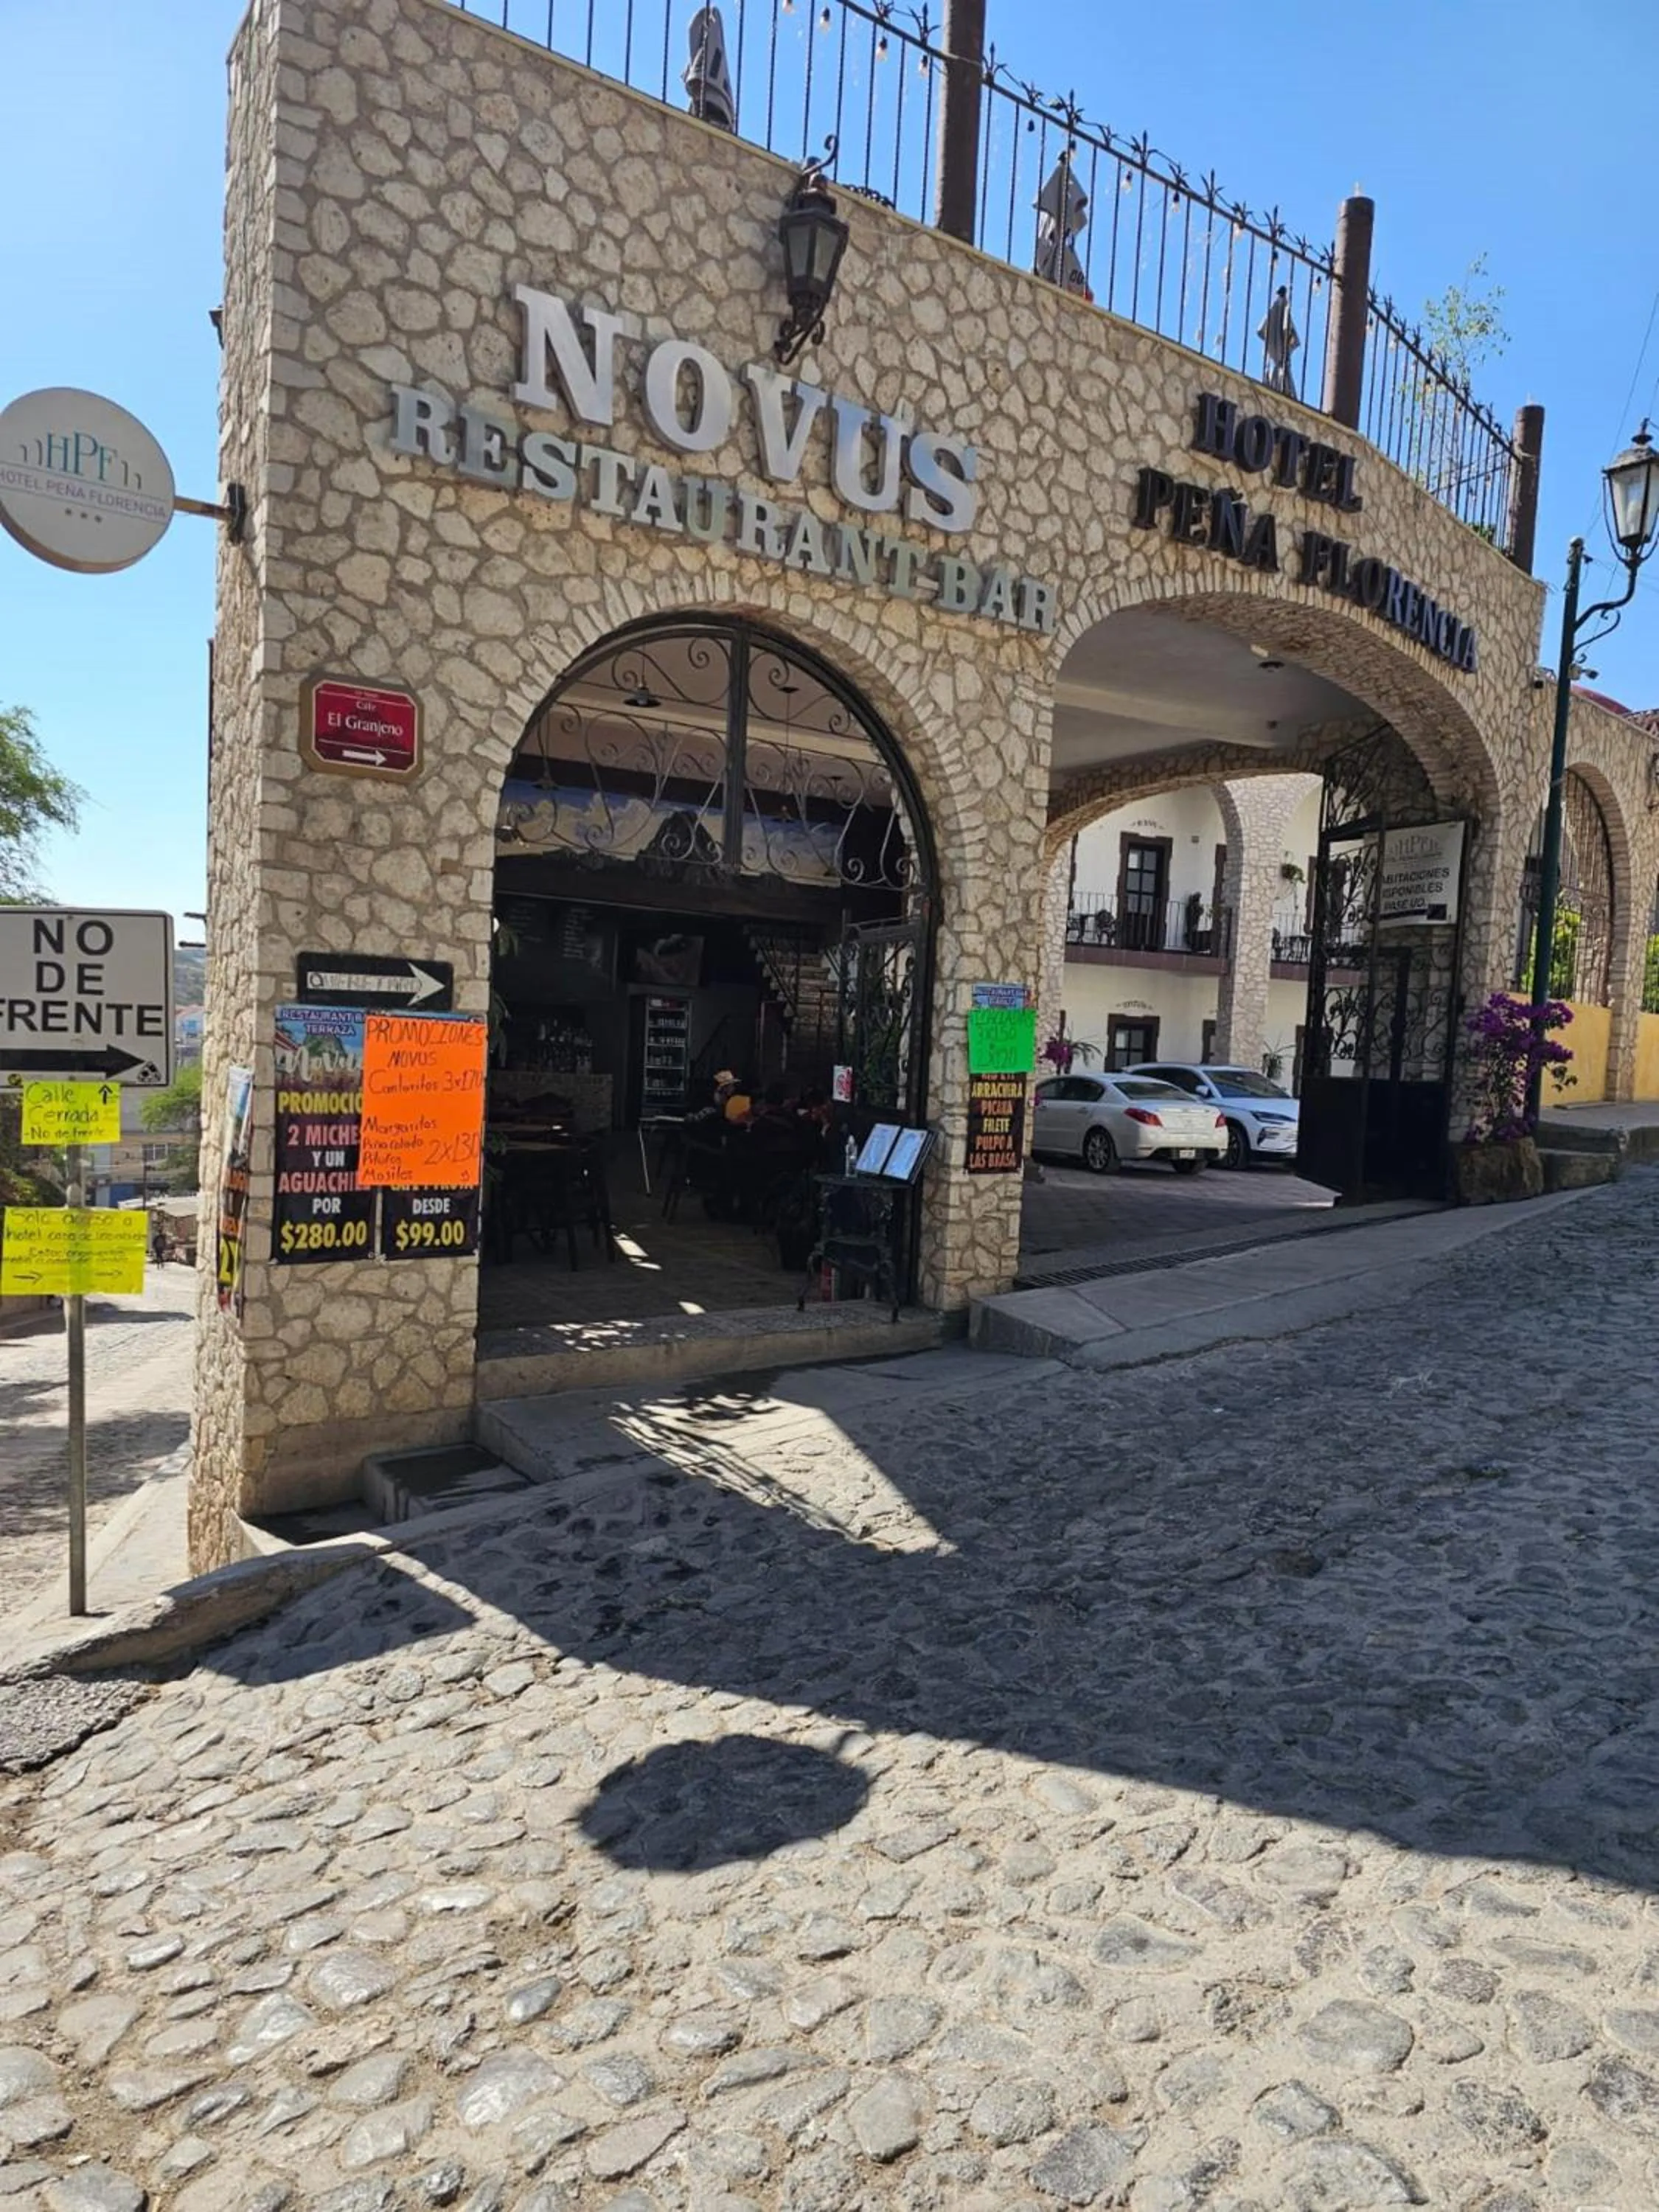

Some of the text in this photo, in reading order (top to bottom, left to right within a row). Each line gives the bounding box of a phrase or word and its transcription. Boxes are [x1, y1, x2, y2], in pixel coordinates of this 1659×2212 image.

[512, 284, 978, 533] NOVUS
[1192, 392, 1363, 513] HOTEL
[88, 489, 166, 518] FLORENCIA
[389, 383, 1059, 636] RESTAURANT BAR
[1132, 467, 1478, 674] PEÑA FLORENCIA
[327, 711, 404, 737] El Granjeno
[34, 919, 114, 956] NO
[36, 961, 105, 995] DE
[306, 1023, 355, 1035] TERRAZA
[387, 1049, 437, 1068] NOVUS
[27, 1082, 77, 1105] Calle
[971, 1082, 1023, 1098] ARRACHERA
[29, 1103, 99, 1125] Cerrada
[983, 1117, 1010, 1133] FILETE
[288, 1124, 299, 1146] 2
[975, 1135, 1013, 1150] PULPO A
[312, 1150, 345, 1167] Y UN
[313, 1197, 341, 1214] POR
[412, 1198, 451, 1214] DESDE
[281, 1220, 366, 1253] $280.00
[396, 1220, 465, 1251] $99.00
